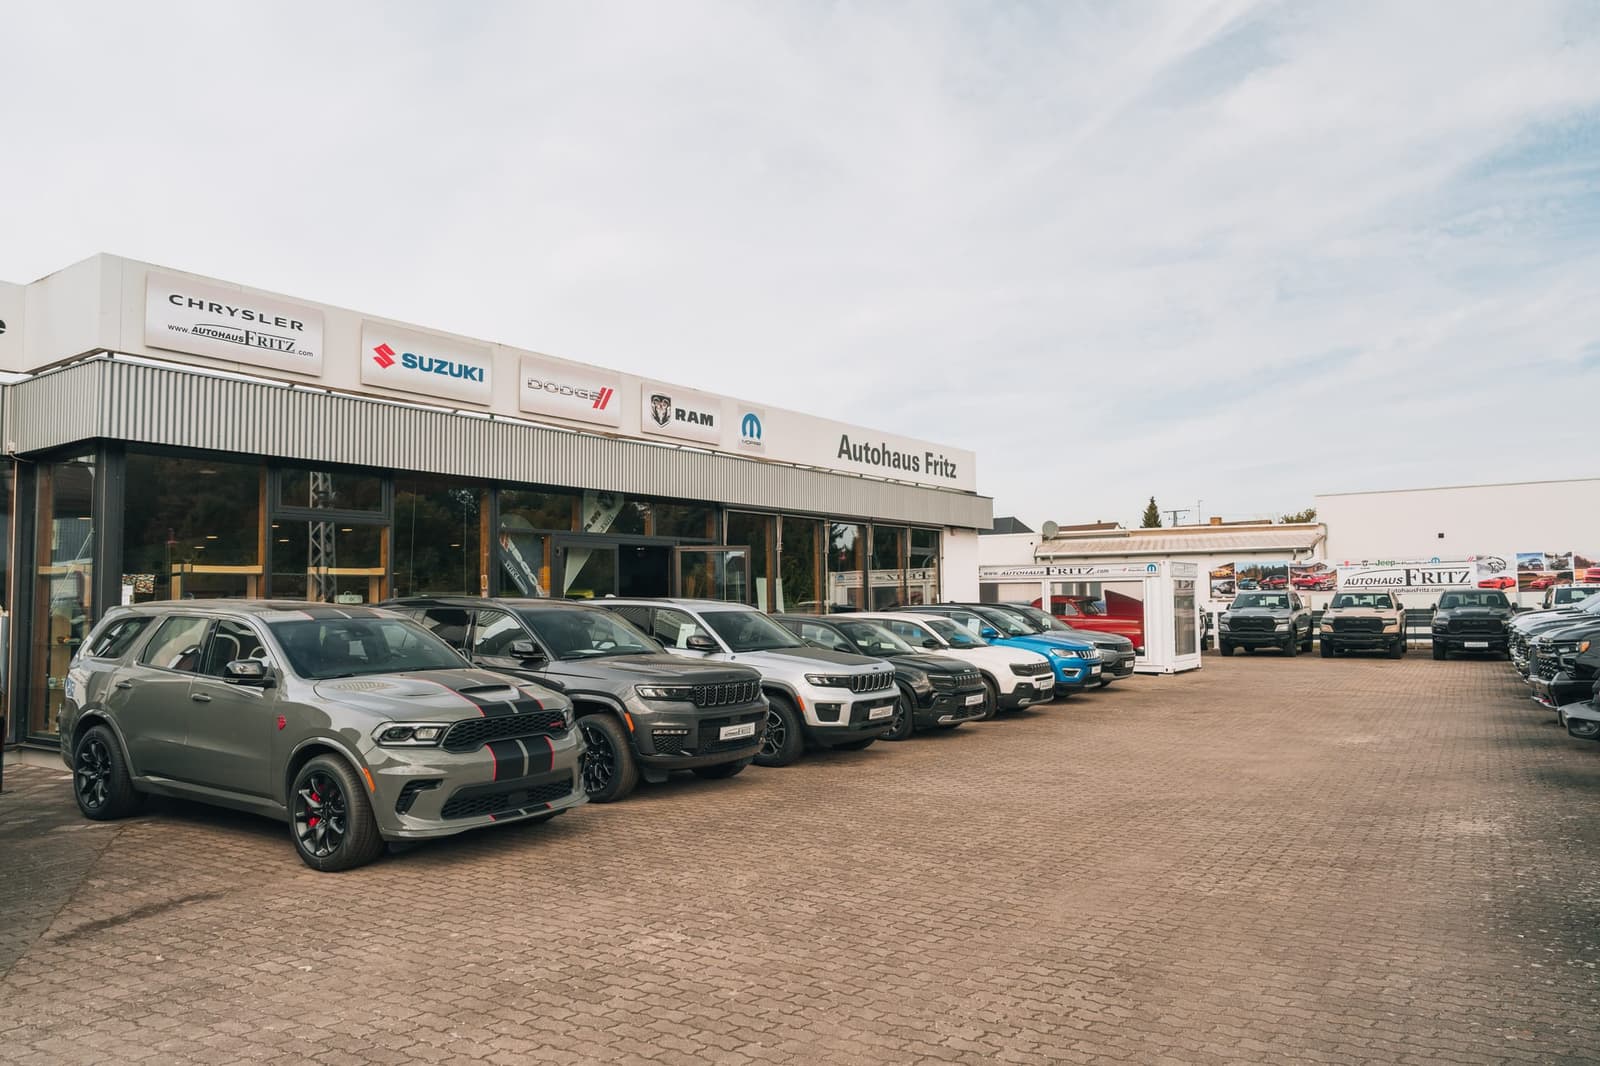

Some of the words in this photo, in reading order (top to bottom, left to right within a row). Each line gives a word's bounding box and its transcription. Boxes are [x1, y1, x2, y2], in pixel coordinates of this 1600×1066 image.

[168, 294, 304, 331] CHRYSLER
[401, 352, 485, 382] SUZUKI
[527, 379, 601, 402] DODGE
[675, 407, 714, 427] RAM
[837, 434, 920, 473] Autohaus
[925, 451, 957, 479] Fritz
[1375, 559, 1396, 567] Jeep
